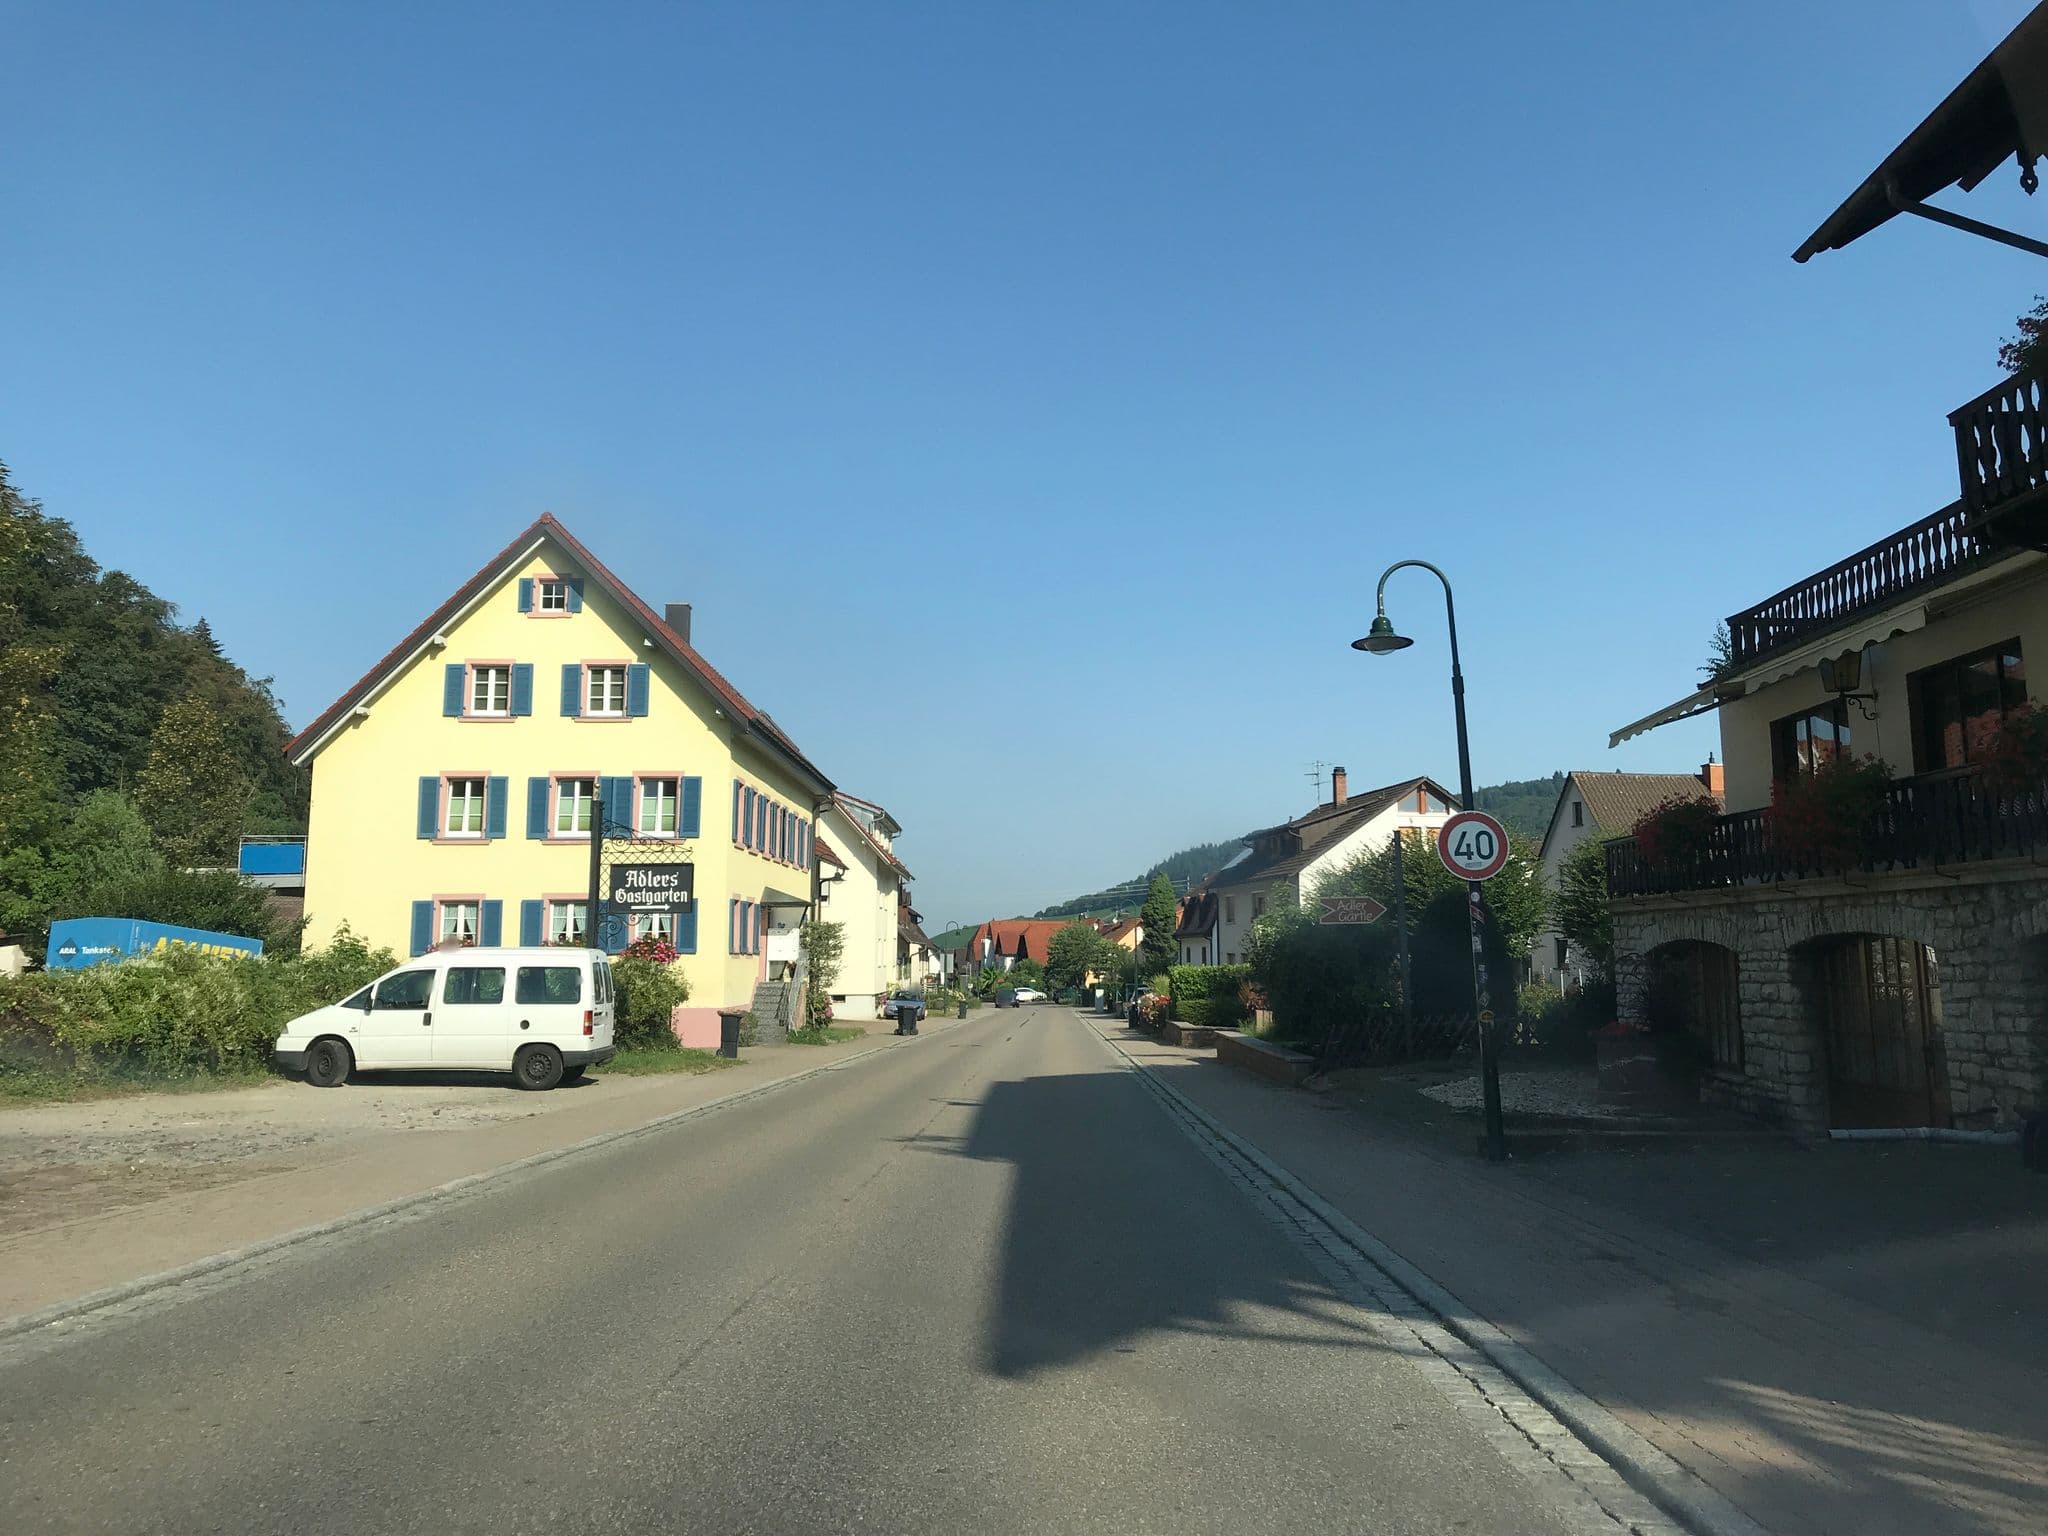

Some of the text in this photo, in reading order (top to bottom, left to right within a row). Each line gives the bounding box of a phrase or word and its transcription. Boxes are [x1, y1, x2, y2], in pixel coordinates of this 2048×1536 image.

[1454, 830, 1494, 861] 40
[625, 870, 679, 887] Adlers
[615, 888, 688, 905] Gastgarten
[1337, 900, 1368, 911] Adler
